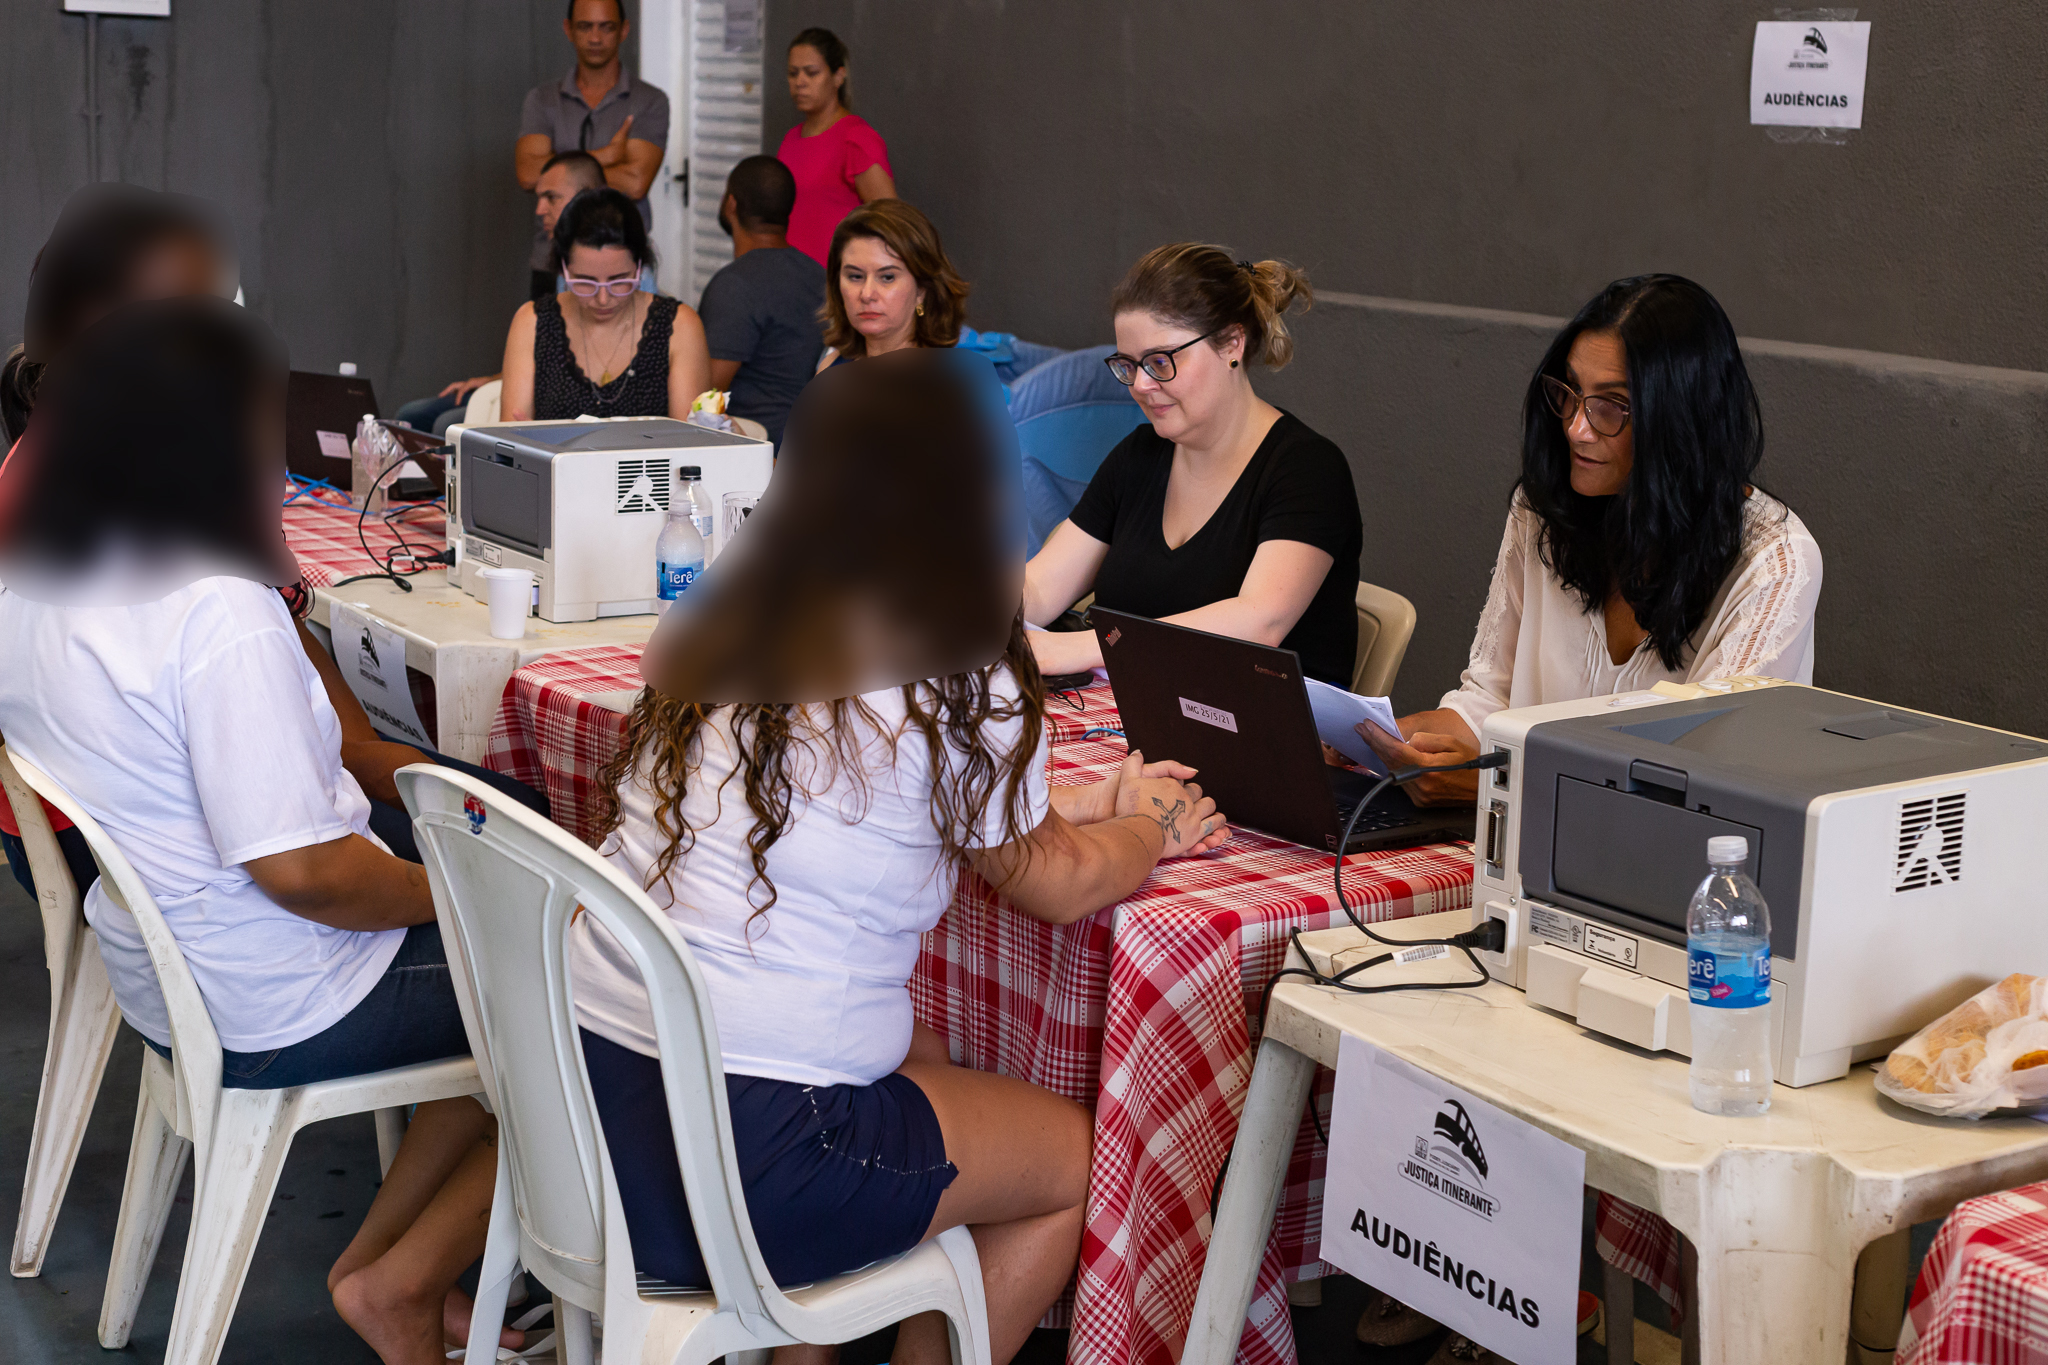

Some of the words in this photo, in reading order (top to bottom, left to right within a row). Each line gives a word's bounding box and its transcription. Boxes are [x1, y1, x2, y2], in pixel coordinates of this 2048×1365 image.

[1764, 91, 1848, 108] AUDIÊNCIAS
[668, 571, 693, 584] Terê
[1689, 958, 1715, 979] erê
[1404, 1160, 1440, 1190] JUSTIÇA
[1441, 1179, 1493, 1217] ITINERANTE
[1350, 1208, 1540, 1329] AUDIÊNCIAS
